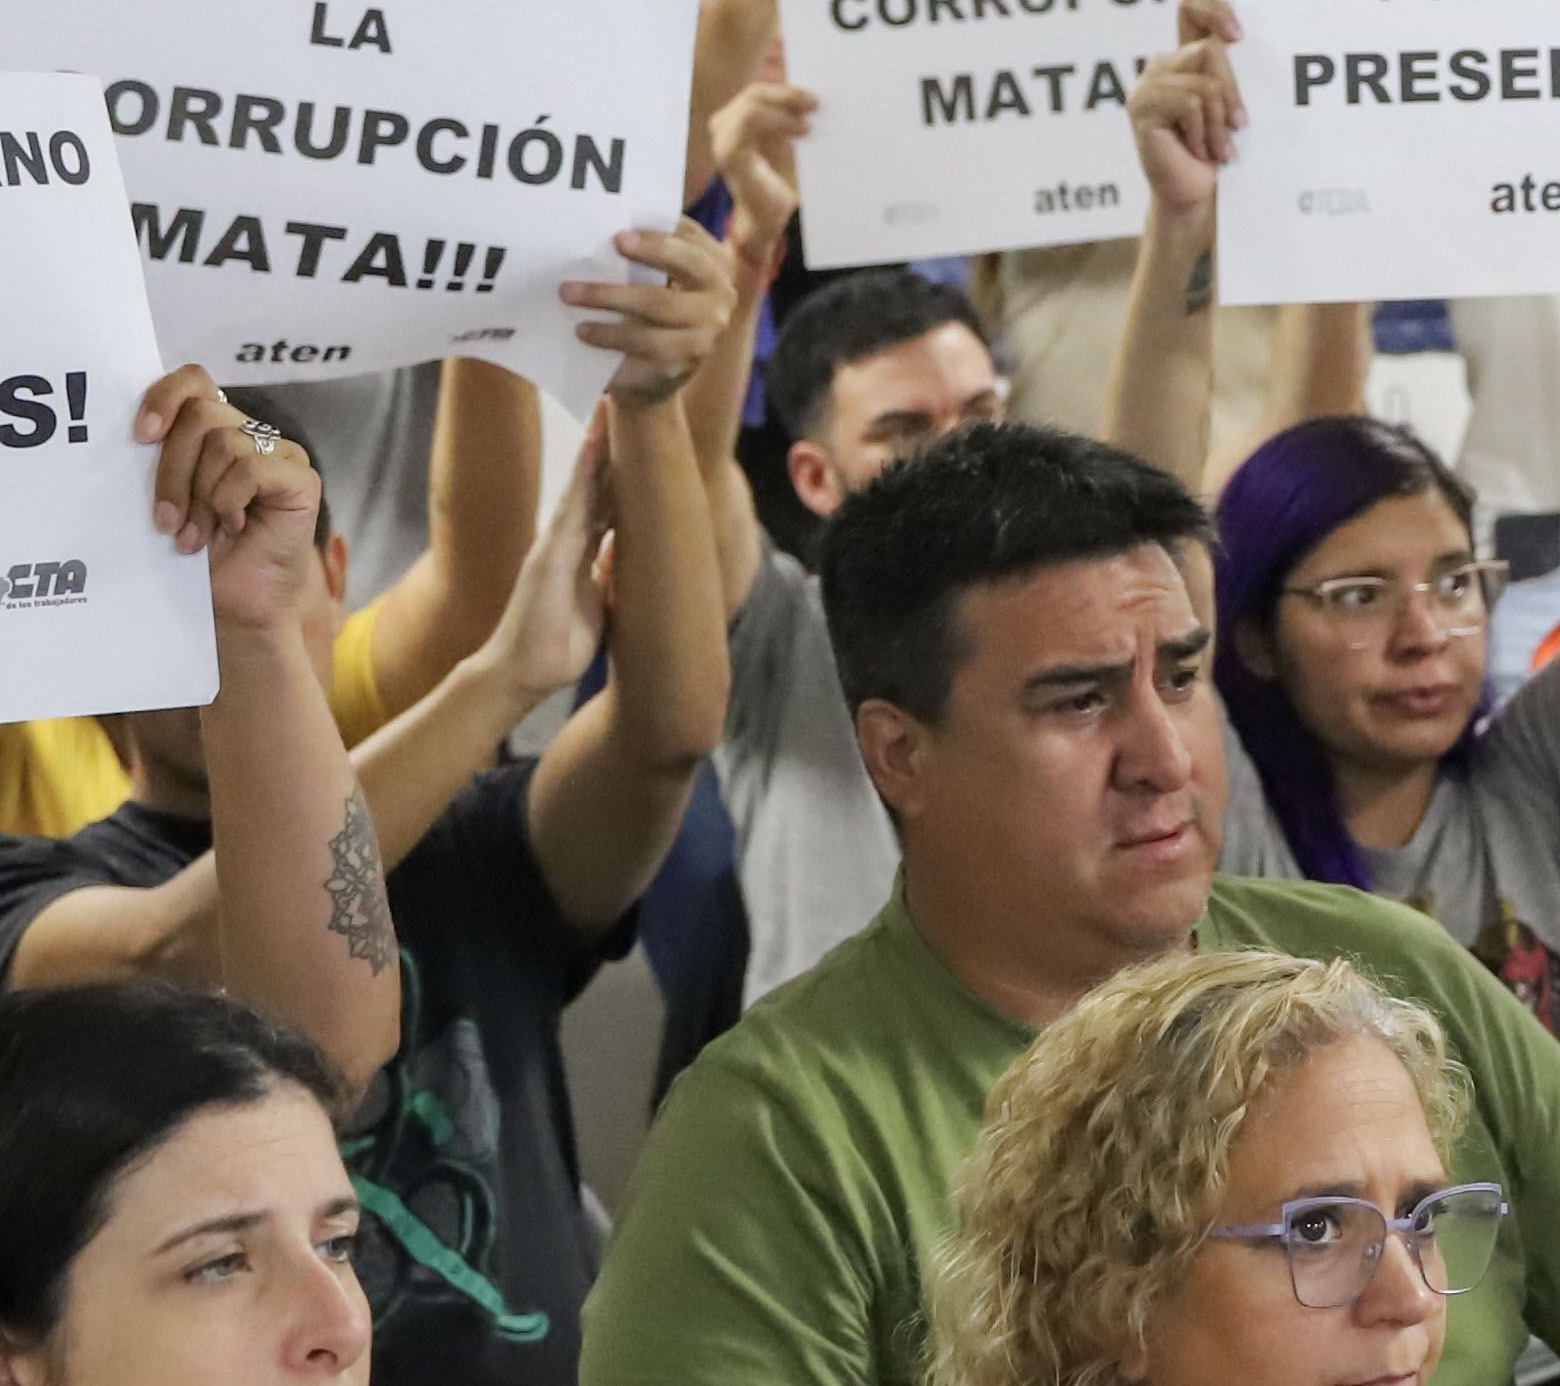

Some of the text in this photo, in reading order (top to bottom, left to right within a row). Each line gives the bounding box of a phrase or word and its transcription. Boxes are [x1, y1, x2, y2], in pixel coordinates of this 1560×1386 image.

[310, 1, 392, 54] LA
[106, 79, 626, 195] ORRUPCIÓN
[1034, 181, 1120, 214] aten
[130, 201, 507, 294] MATA!!!
[235, 340, 352, 363] aten
[7, 559, 87, 599] CTA
